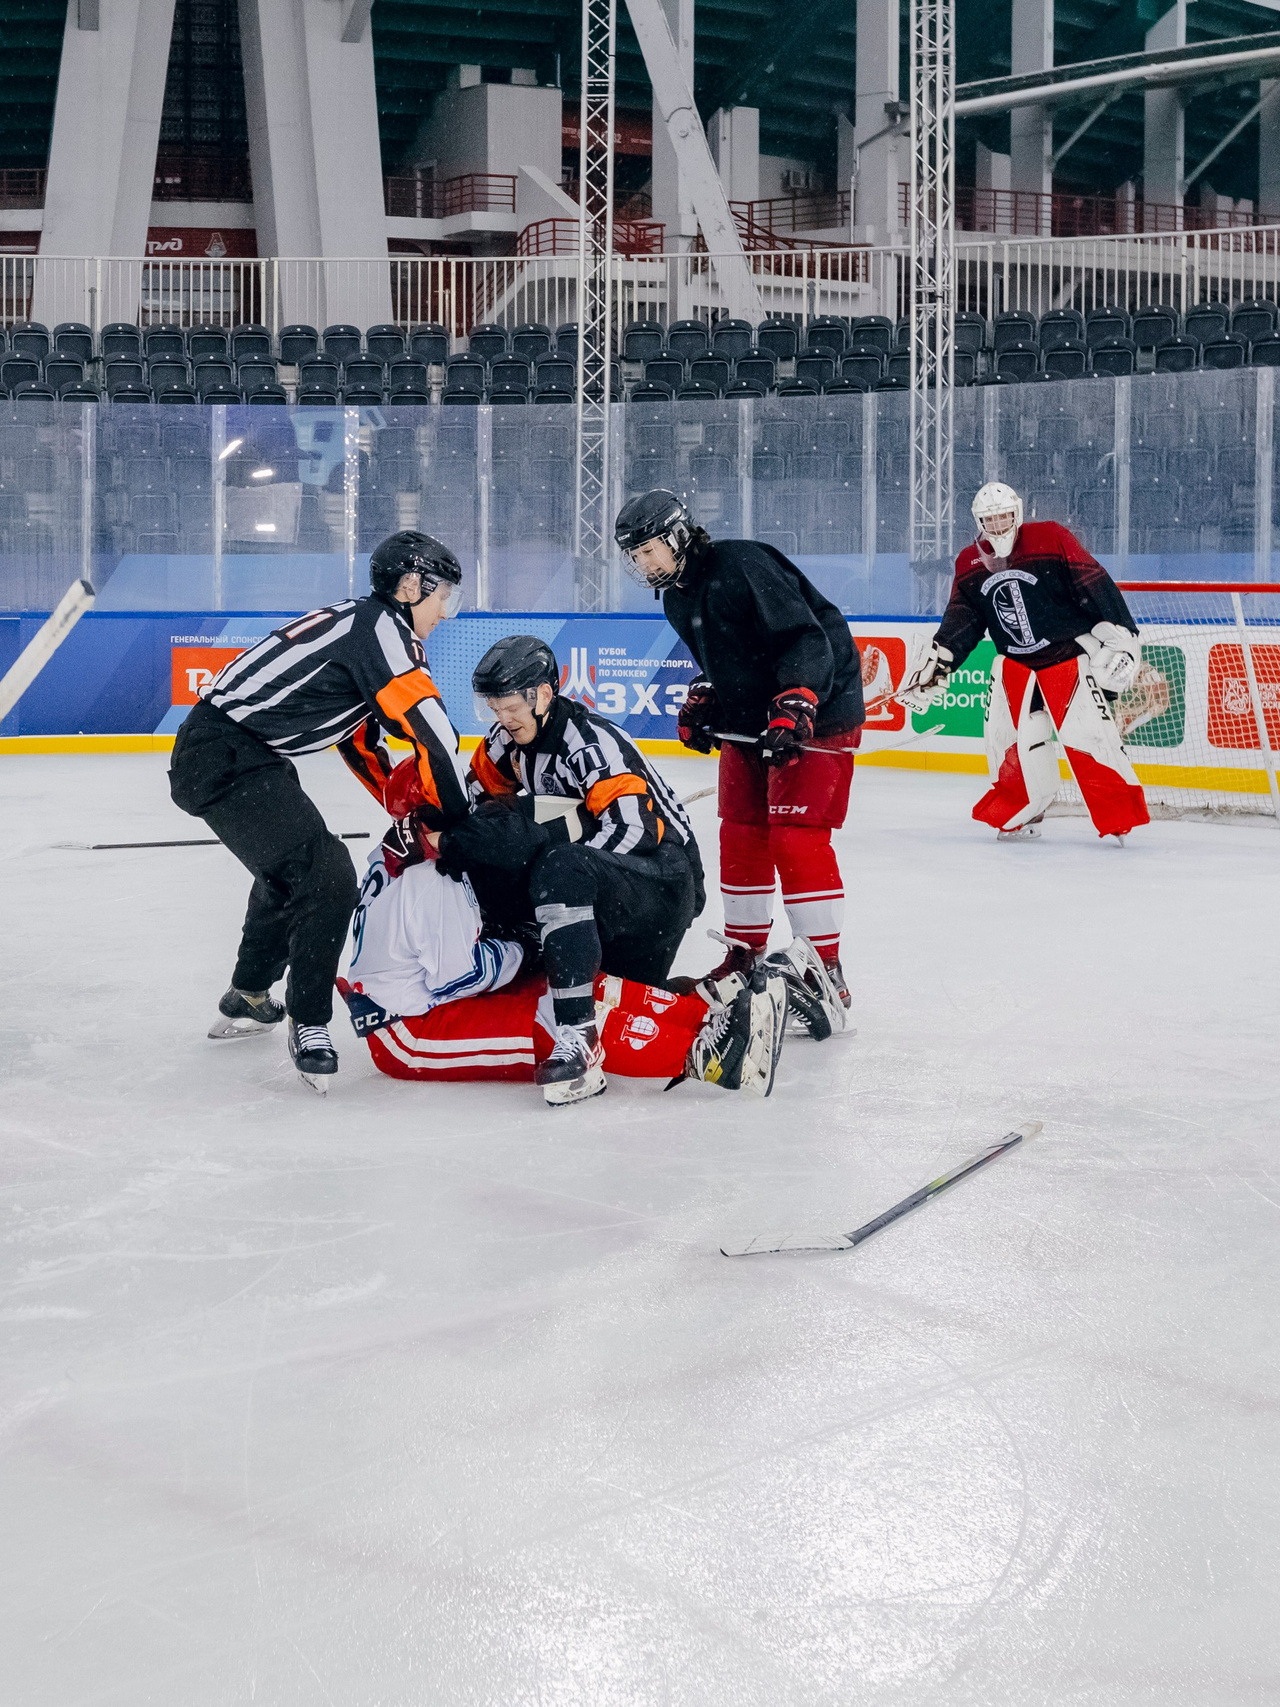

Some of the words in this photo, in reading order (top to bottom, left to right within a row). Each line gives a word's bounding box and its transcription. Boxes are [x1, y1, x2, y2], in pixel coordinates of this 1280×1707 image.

[1010, 581, 1035, 645] DOMINATION
[170, 635, 228, 644] ГЕНЕРАЛЬНЫЙ
[231, 636, 270, 644] СПОНСО
[598, 647, 627, 656] КУБОК
[598, 658, 659, 668] МОСКОВСКОГО
[661, 659, 694, 669] СПОРТА
[598, 669, 610, 677] ПО
[612, 669, 648, 678] ХОККЕЮ
[901, 698, 923, 712] CCM
[931, 691, 987, 710] sport
[984, 675, 996, 722] CCM
[1085, 674, 1111, 722] CCM
[572, 746, 603, 780] 71
[769, 805, 809, 815] CCM
